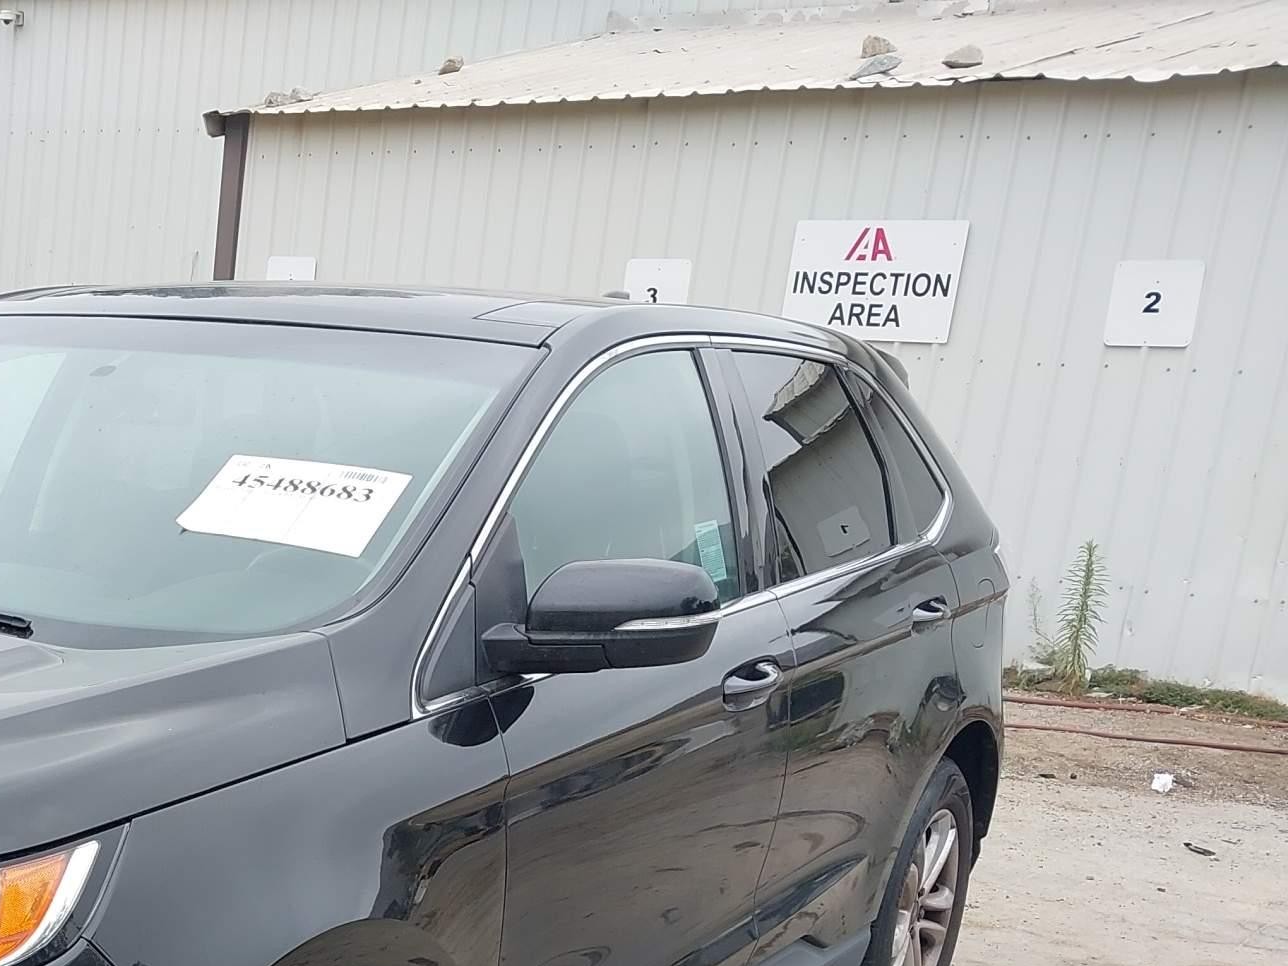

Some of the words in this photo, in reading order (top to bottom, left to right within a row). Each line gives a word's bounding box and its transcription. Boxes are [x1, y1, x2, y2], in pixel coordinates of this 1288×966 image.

[645, 287, 658, 304] 3
[792, 271, 952, 297] INSPECTION
[827, 302, 900, 327] AREA
[1142, 291, 1162, 313] 2
[232, 473, 374, 503] 45488683
